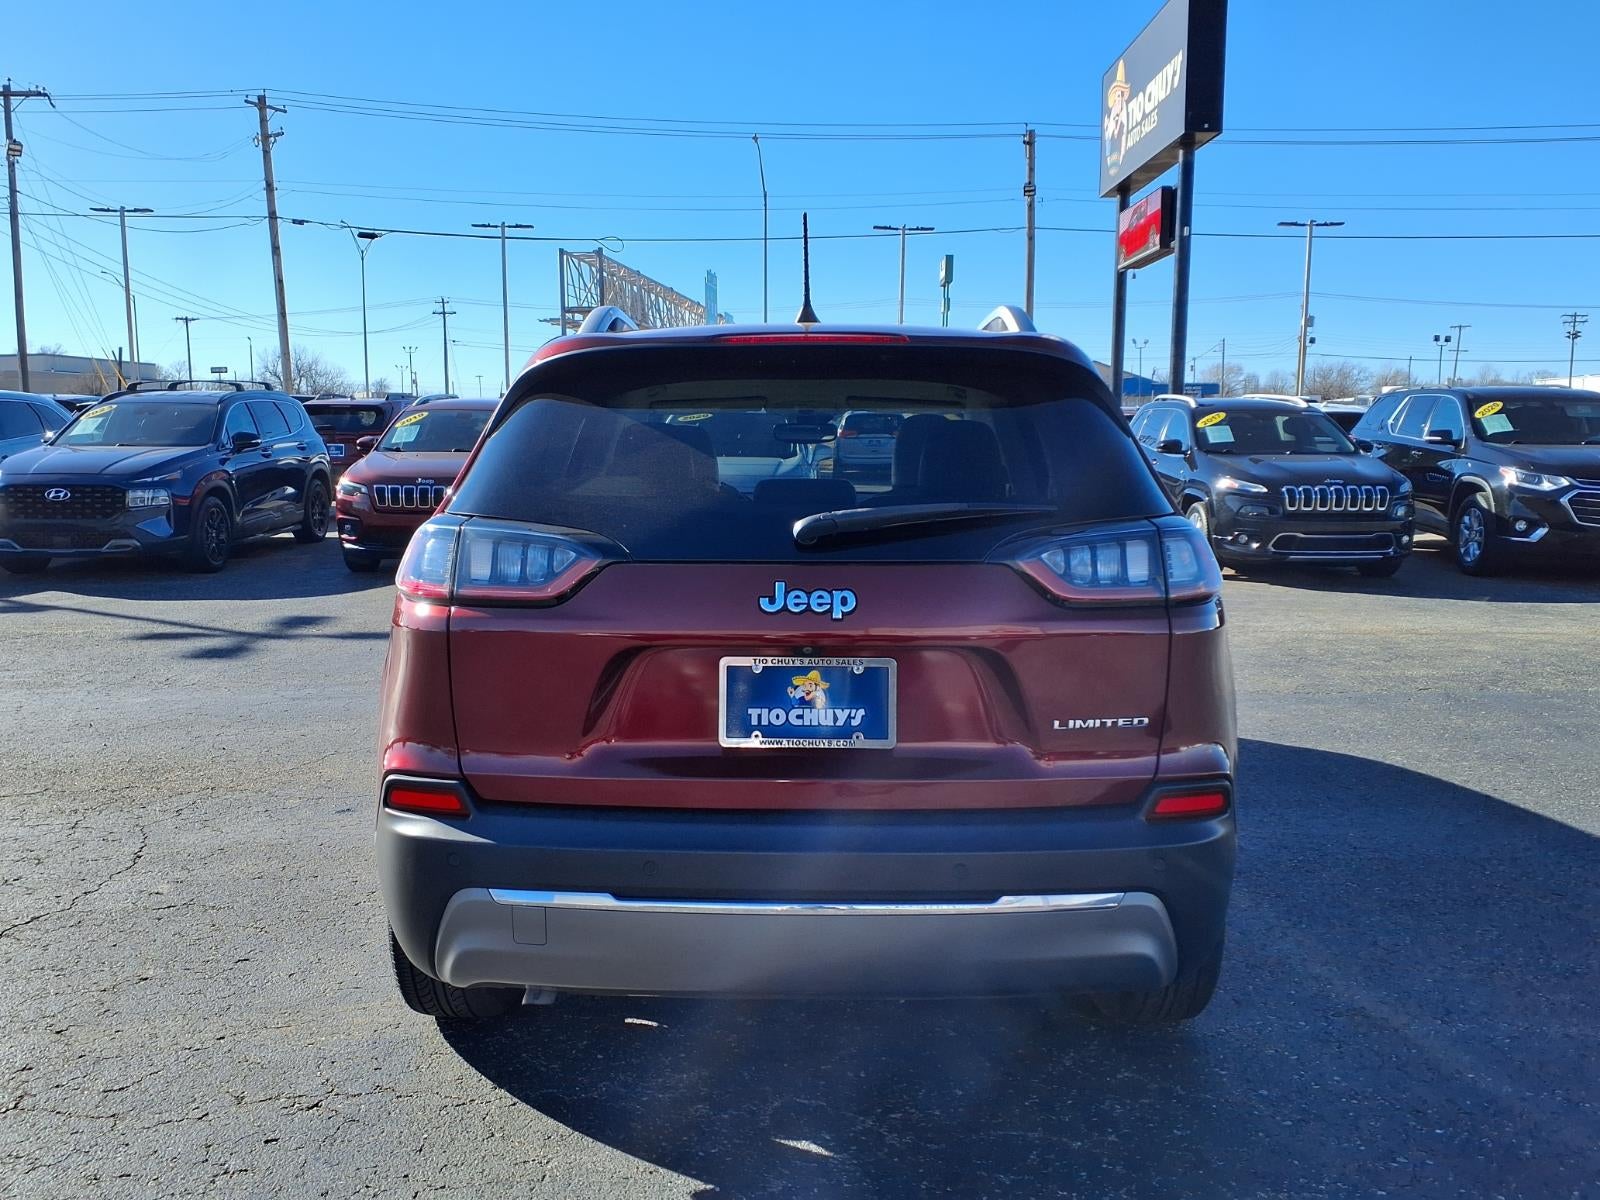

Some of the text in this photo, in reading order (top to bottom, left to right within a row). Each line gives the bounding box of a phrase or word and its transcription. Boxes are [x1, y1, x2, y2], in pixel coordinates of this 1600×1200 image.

[1127, 91, 1144, 130] TIO
[1126, 108, 1158, 150] AUTO SALES
[1478, 402, 1500, 416] 2020
[1201, 412, 1222, 425] 2017
[415, 477, 435, 485] Jeep
[758, 581, 858, 619] Jeep
[752, 658, 865, 667] TIO CHUY'S AUTO SALES
[1053, 717, 1150, 730] LIMITED
[758, 738, 857, 748] WWW.TIOCHUYS.COM
